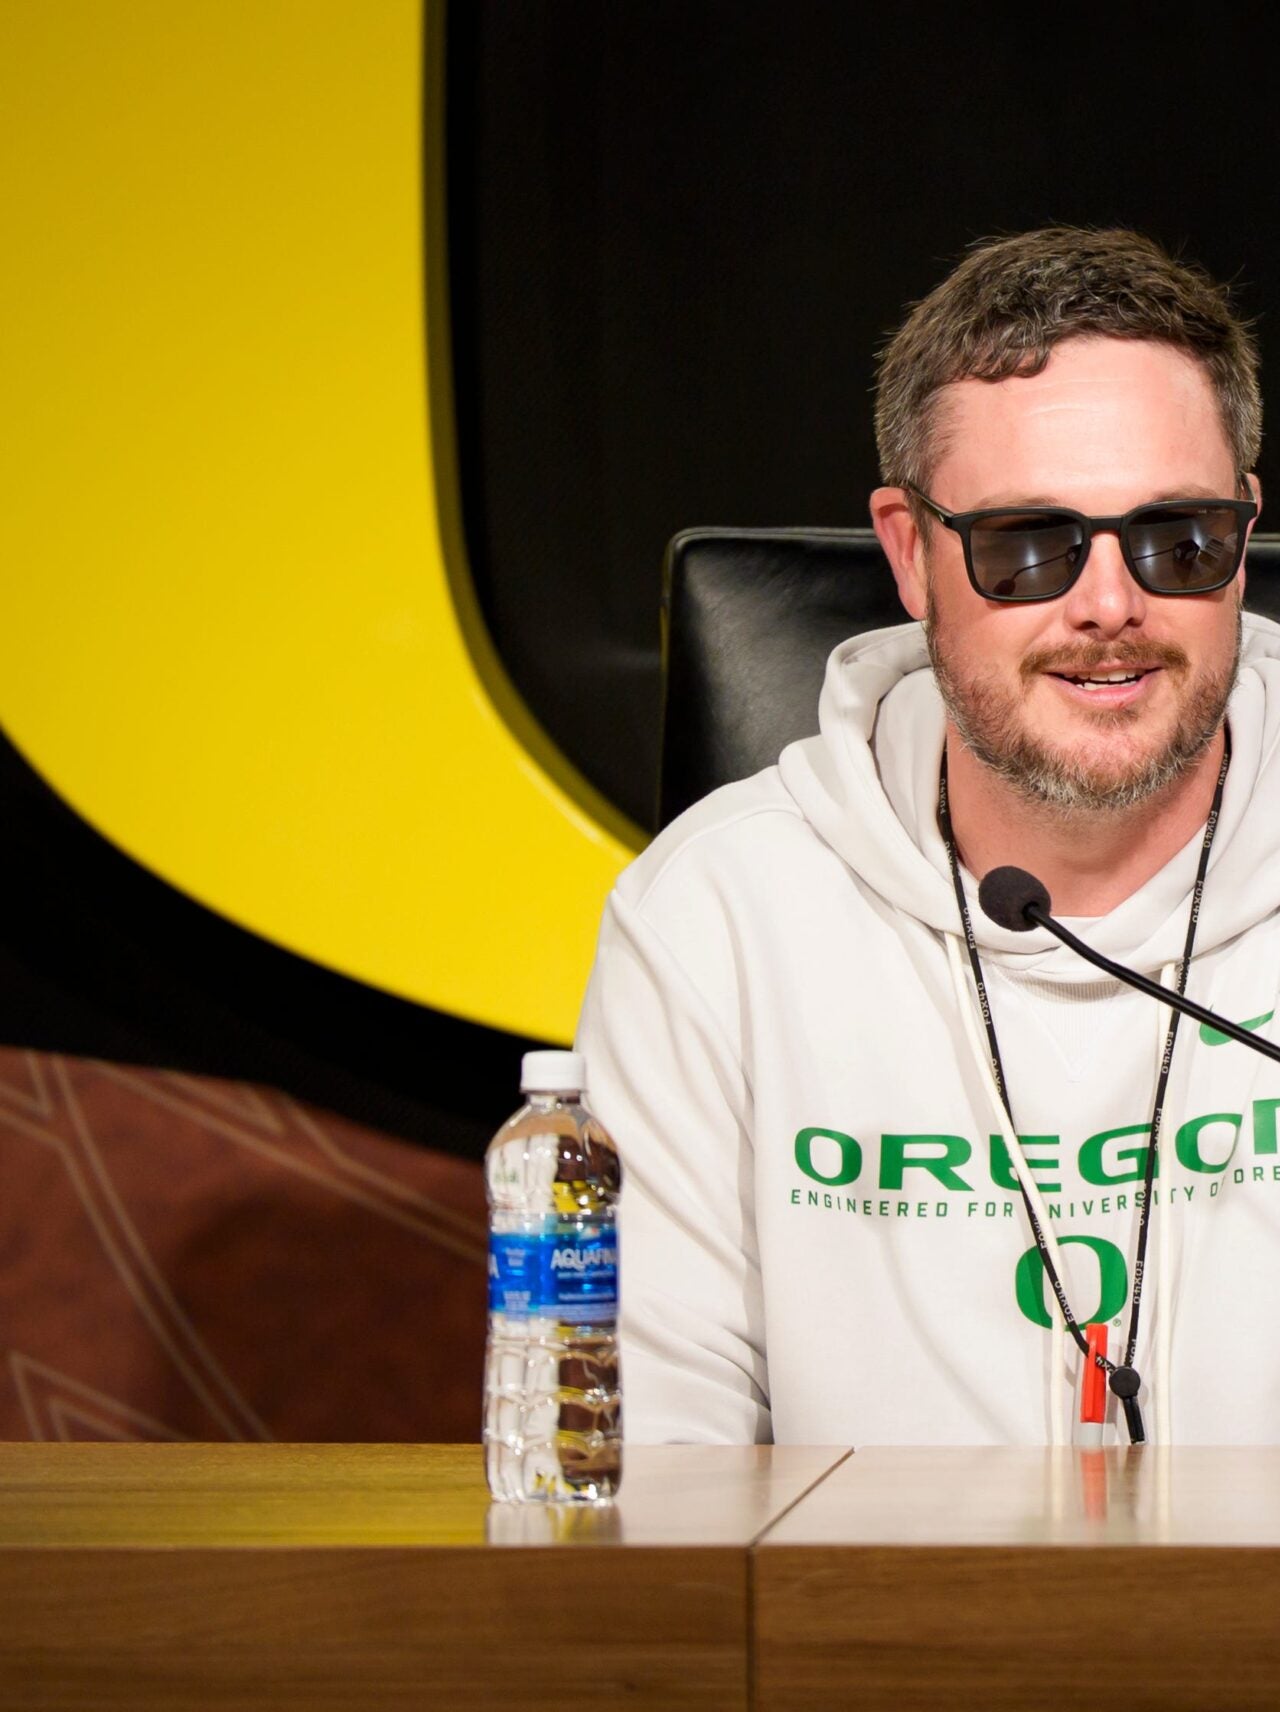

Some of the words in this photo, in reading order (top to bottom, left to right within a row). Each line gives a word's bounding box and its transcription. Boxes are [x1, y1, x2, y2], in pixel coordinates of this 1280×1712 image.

[1202, 810, 1218, 849] FOX40
[1191, 879, 1204, 925] FOX40
[976, 982, 992, 1025] FOX40
[1160, 1030, 1175, 1075] FOX40
[790, 1189, 948, 1217] ENGINEERED
[967, 1203, 1014, 1217] FOR
[1049, 1186, 1195, 1218] NIVERSITY
[1210, 1178, 1225, 1198] O
[1014, 1235, 1128, 1332] O
[1132, 1259, 1144, 1306] FOX40
